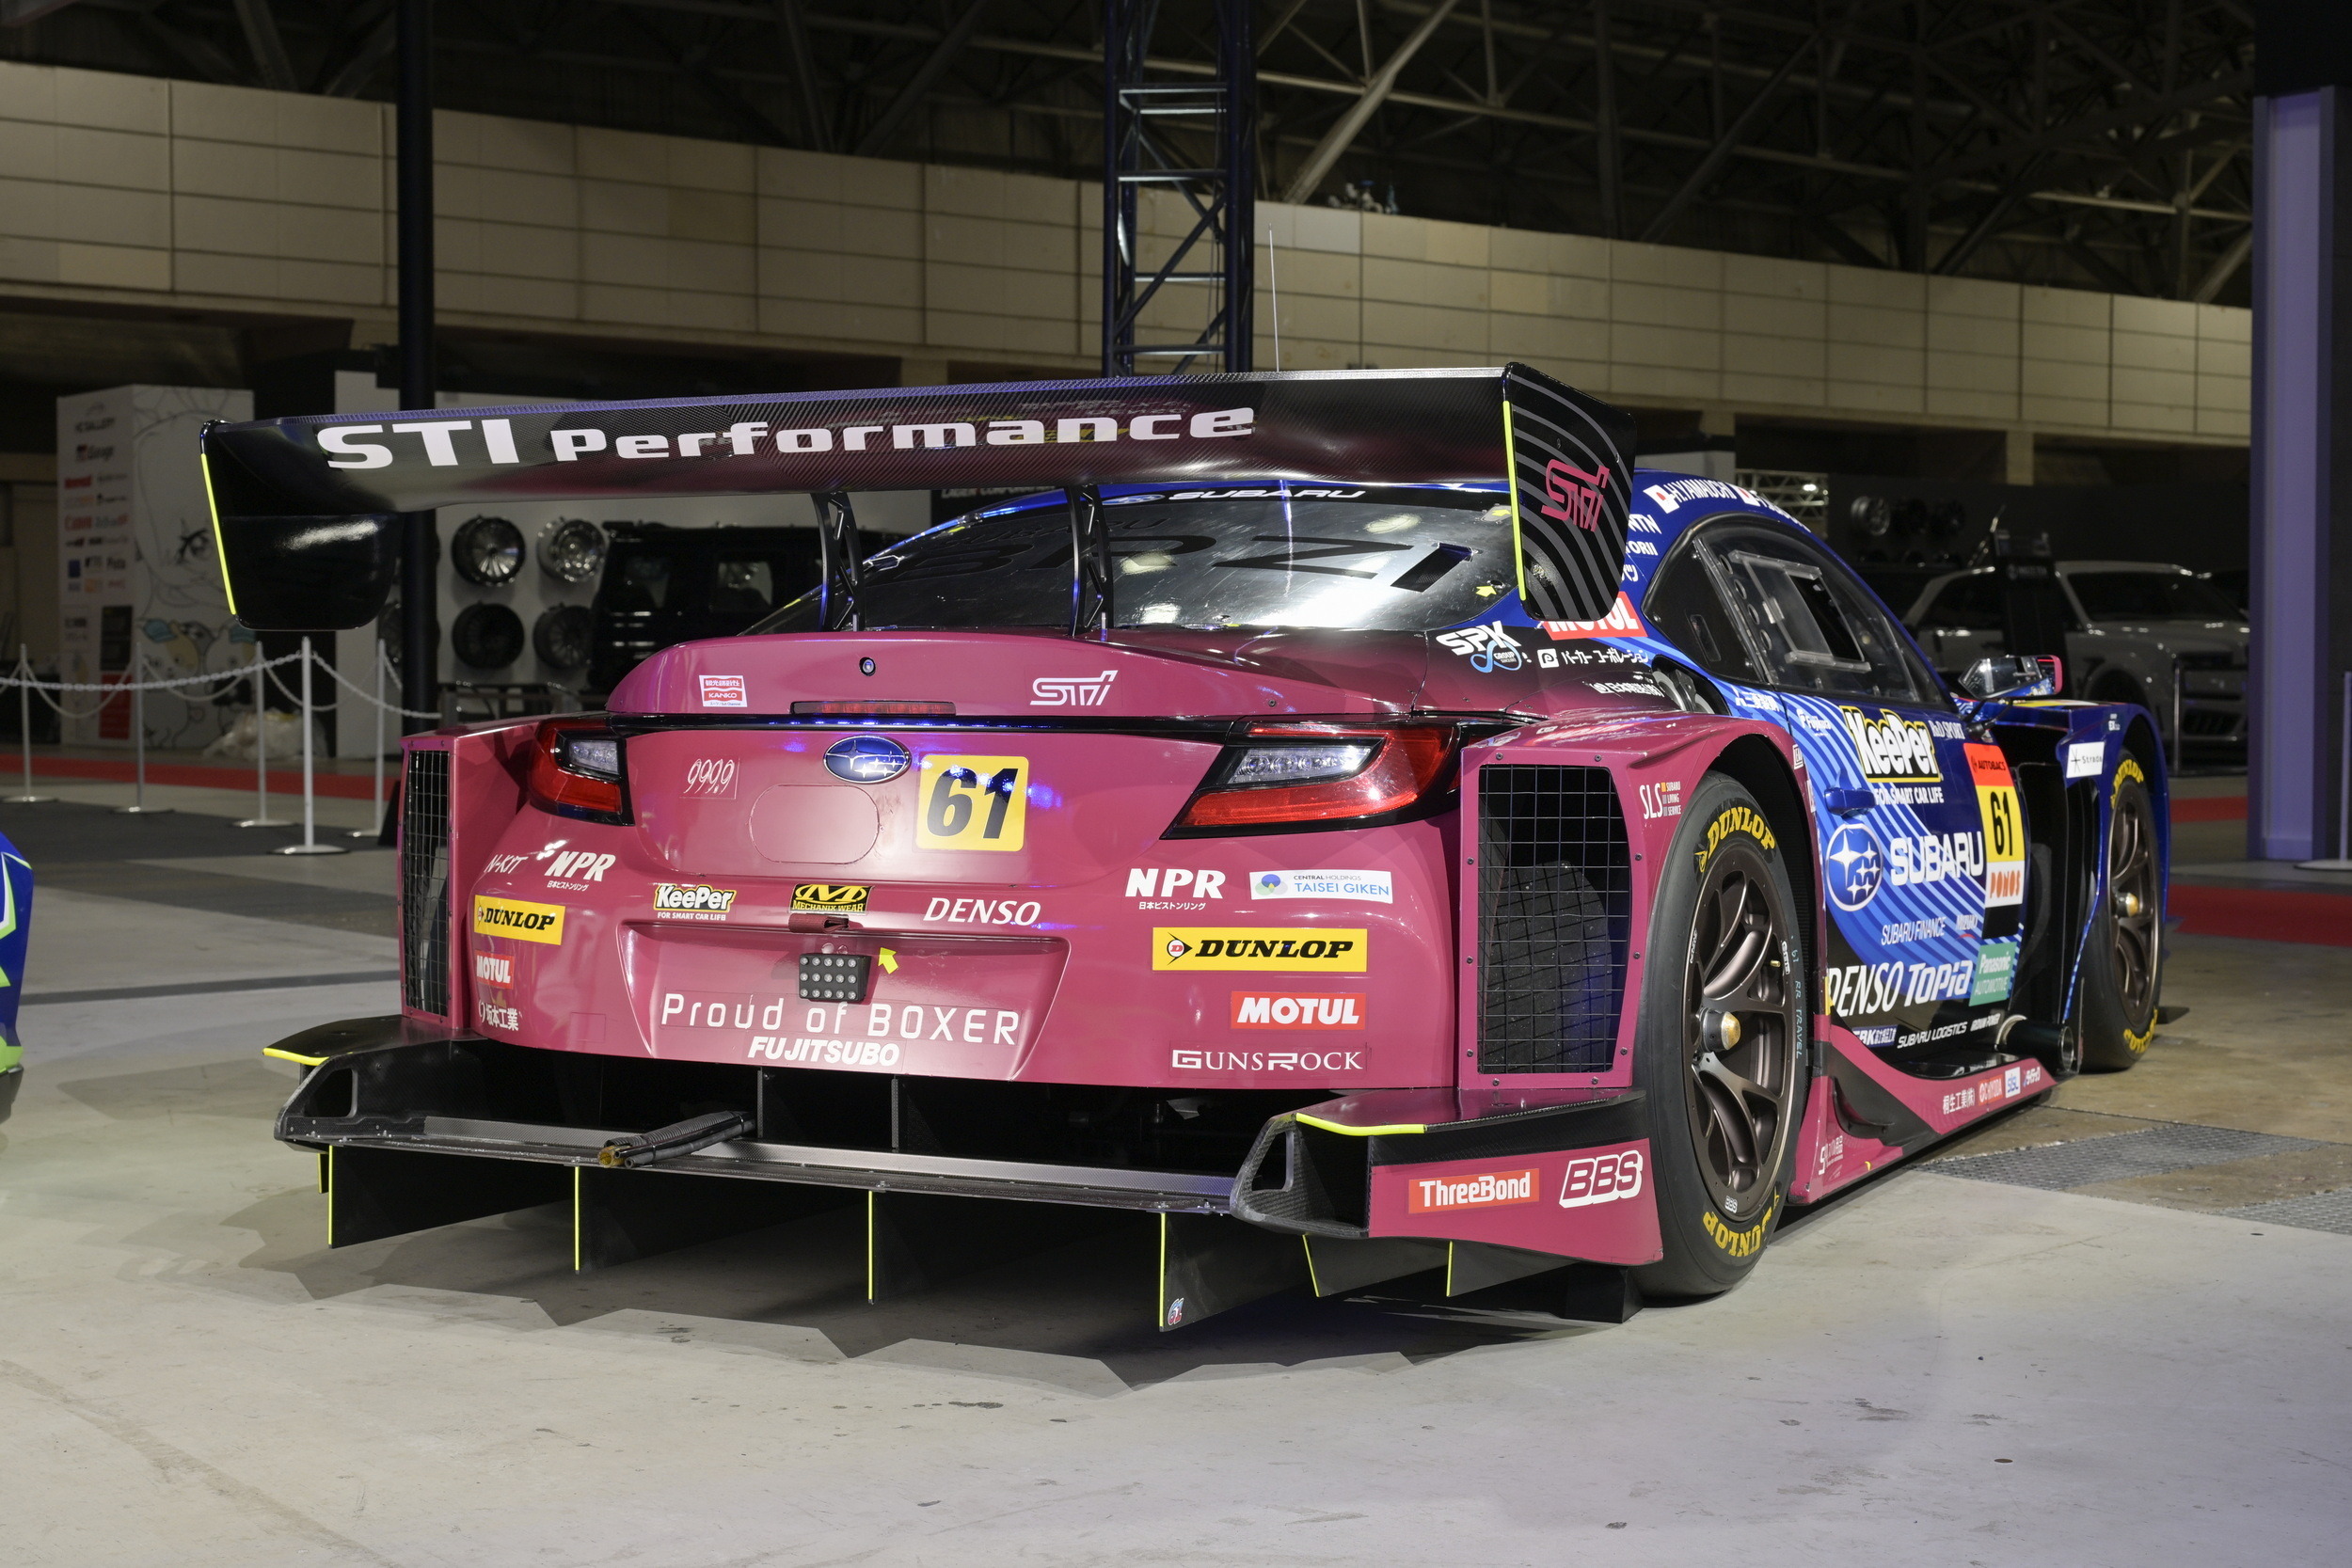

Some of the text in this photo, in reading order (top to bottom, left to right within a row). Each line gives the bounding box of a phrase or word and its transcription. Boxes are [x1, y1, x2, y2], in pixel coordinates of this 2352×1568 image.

[316, 407, 1254, 469] STI Performance
[1169, 489, 1366, 500] SUBARU
[1436, 621, 1521, 656] SPK
[1845, 711, 1938, 775] KeePer
[926, 768, 1019, 839] 61
[1639, 783, 1662, 819] SLS
[1914, 786, 1930, 804] CAR
[1928, 786, 1945, 803] LIFE
[1708, 807, 1776, 860] DUNLOP
[1990, 791, 2013, 857] 61
[544, 850, 616, 882] NPR
[1890, 832, 1984, 886] SUBARU
[656, 884, 734, 910] KeePer
[1125, 868, 1226, 899] NPR
[1295, 882, 1390, 895] TAISEI GIKEN
[1990, 869, 2022, 899] PONOS
[485, 908, 556, 930] DUNLOP
[792, 900, 864, 912] MECHANIX WEAR
[924, 896, 1041, 927] DENSO
[1138, 901, 1206, 911] 日本ピストンリング
[1881, 916, 1947, 946] SUBARU FINANCE
[1195, 940, 1354, 958] DUNLOP
[1979, 951, 2011, 974] Panasonic
[477, 955, 511, 984] MOTUL
[1827, 961, 1904, 1018] DENSO
[660, 993, 1020, 1046] Proud of BOXER
[1236, 997, 1359, 1024] MOTUL
[1897, 1030, 1931, 1049] SUBARU
[1931, 1022, 1968, 1040] LOGISTICS
[748, 1037, 900, 1068] FUJITSUBO
[1419, 1170, 1531, 1208] ThreeBond
[1560, 1149, 1644, 1209] BBS
